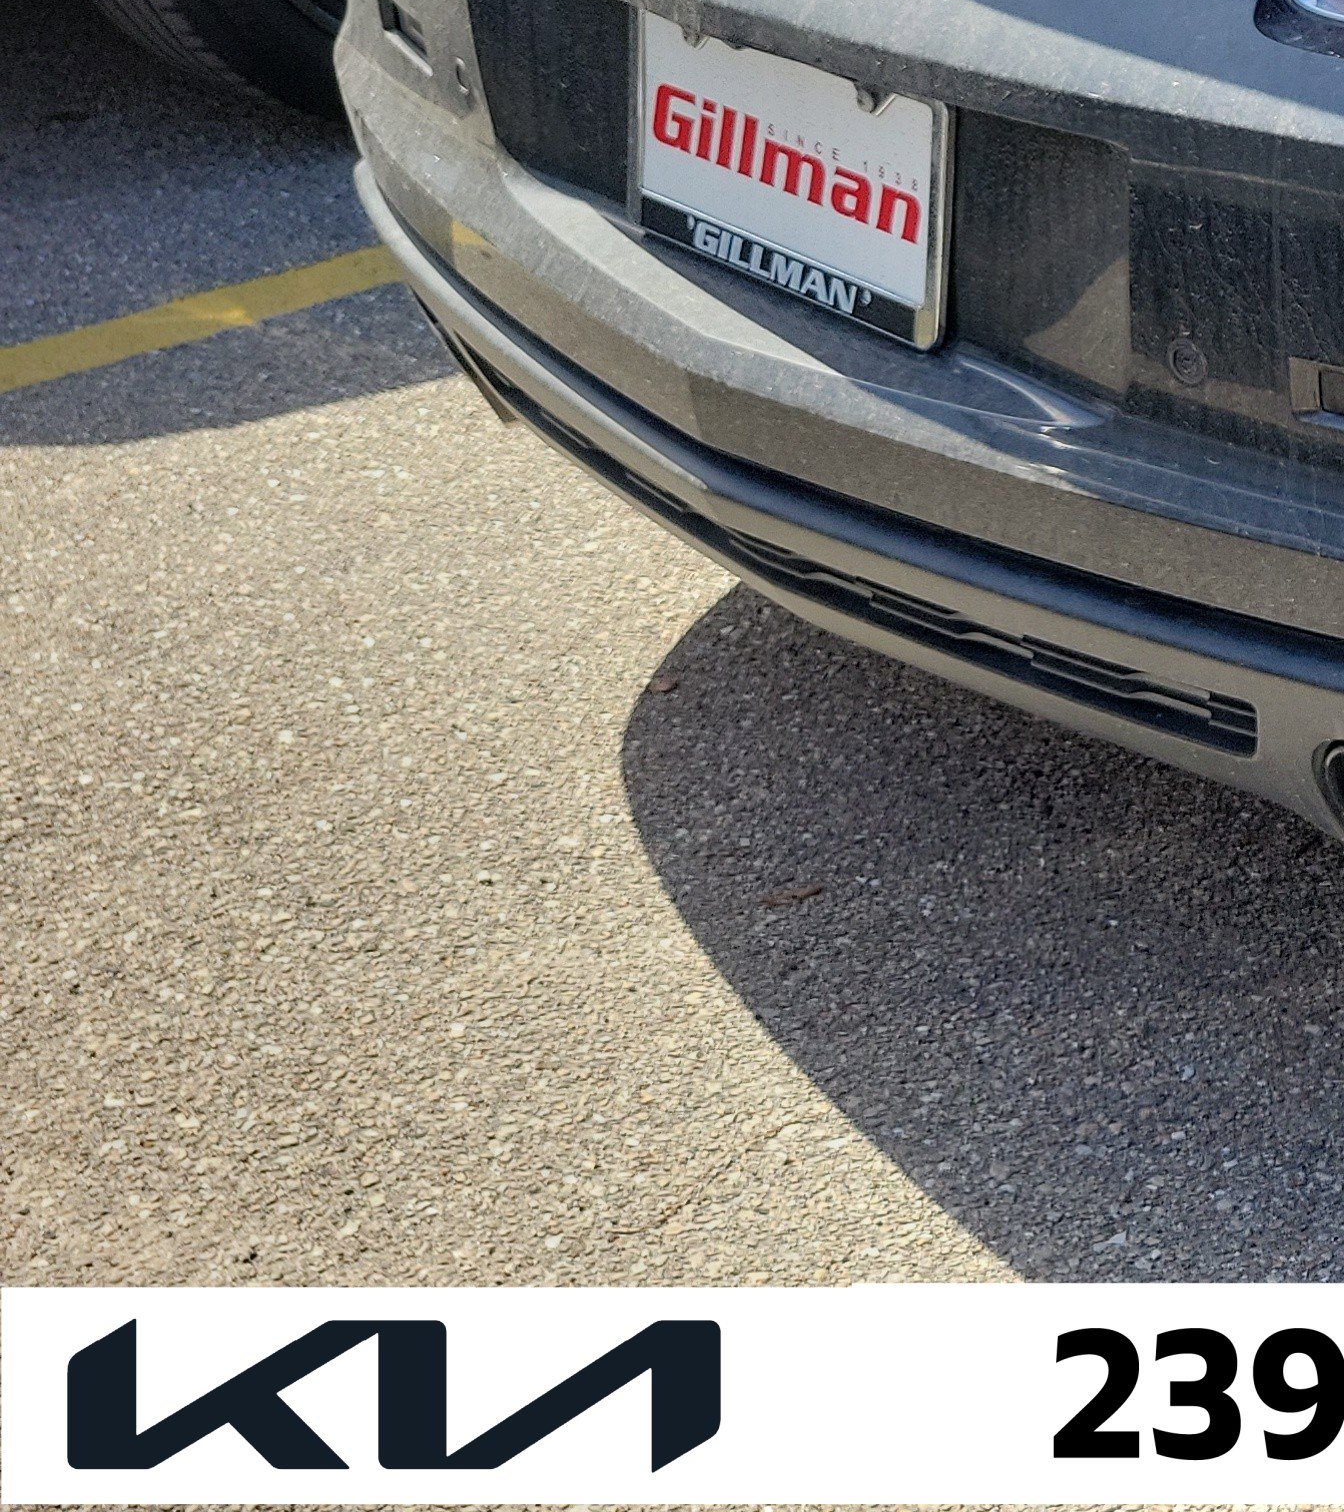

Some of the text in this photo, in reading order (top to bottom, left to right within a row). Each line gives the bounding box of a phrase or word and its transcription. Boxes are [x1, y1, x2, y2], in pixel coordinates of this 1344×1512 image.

[652, 82, 922, 245] Gillman
[767, 122, 841, 162] SINCE
[692, 221, 858, 315] GILLMAN
